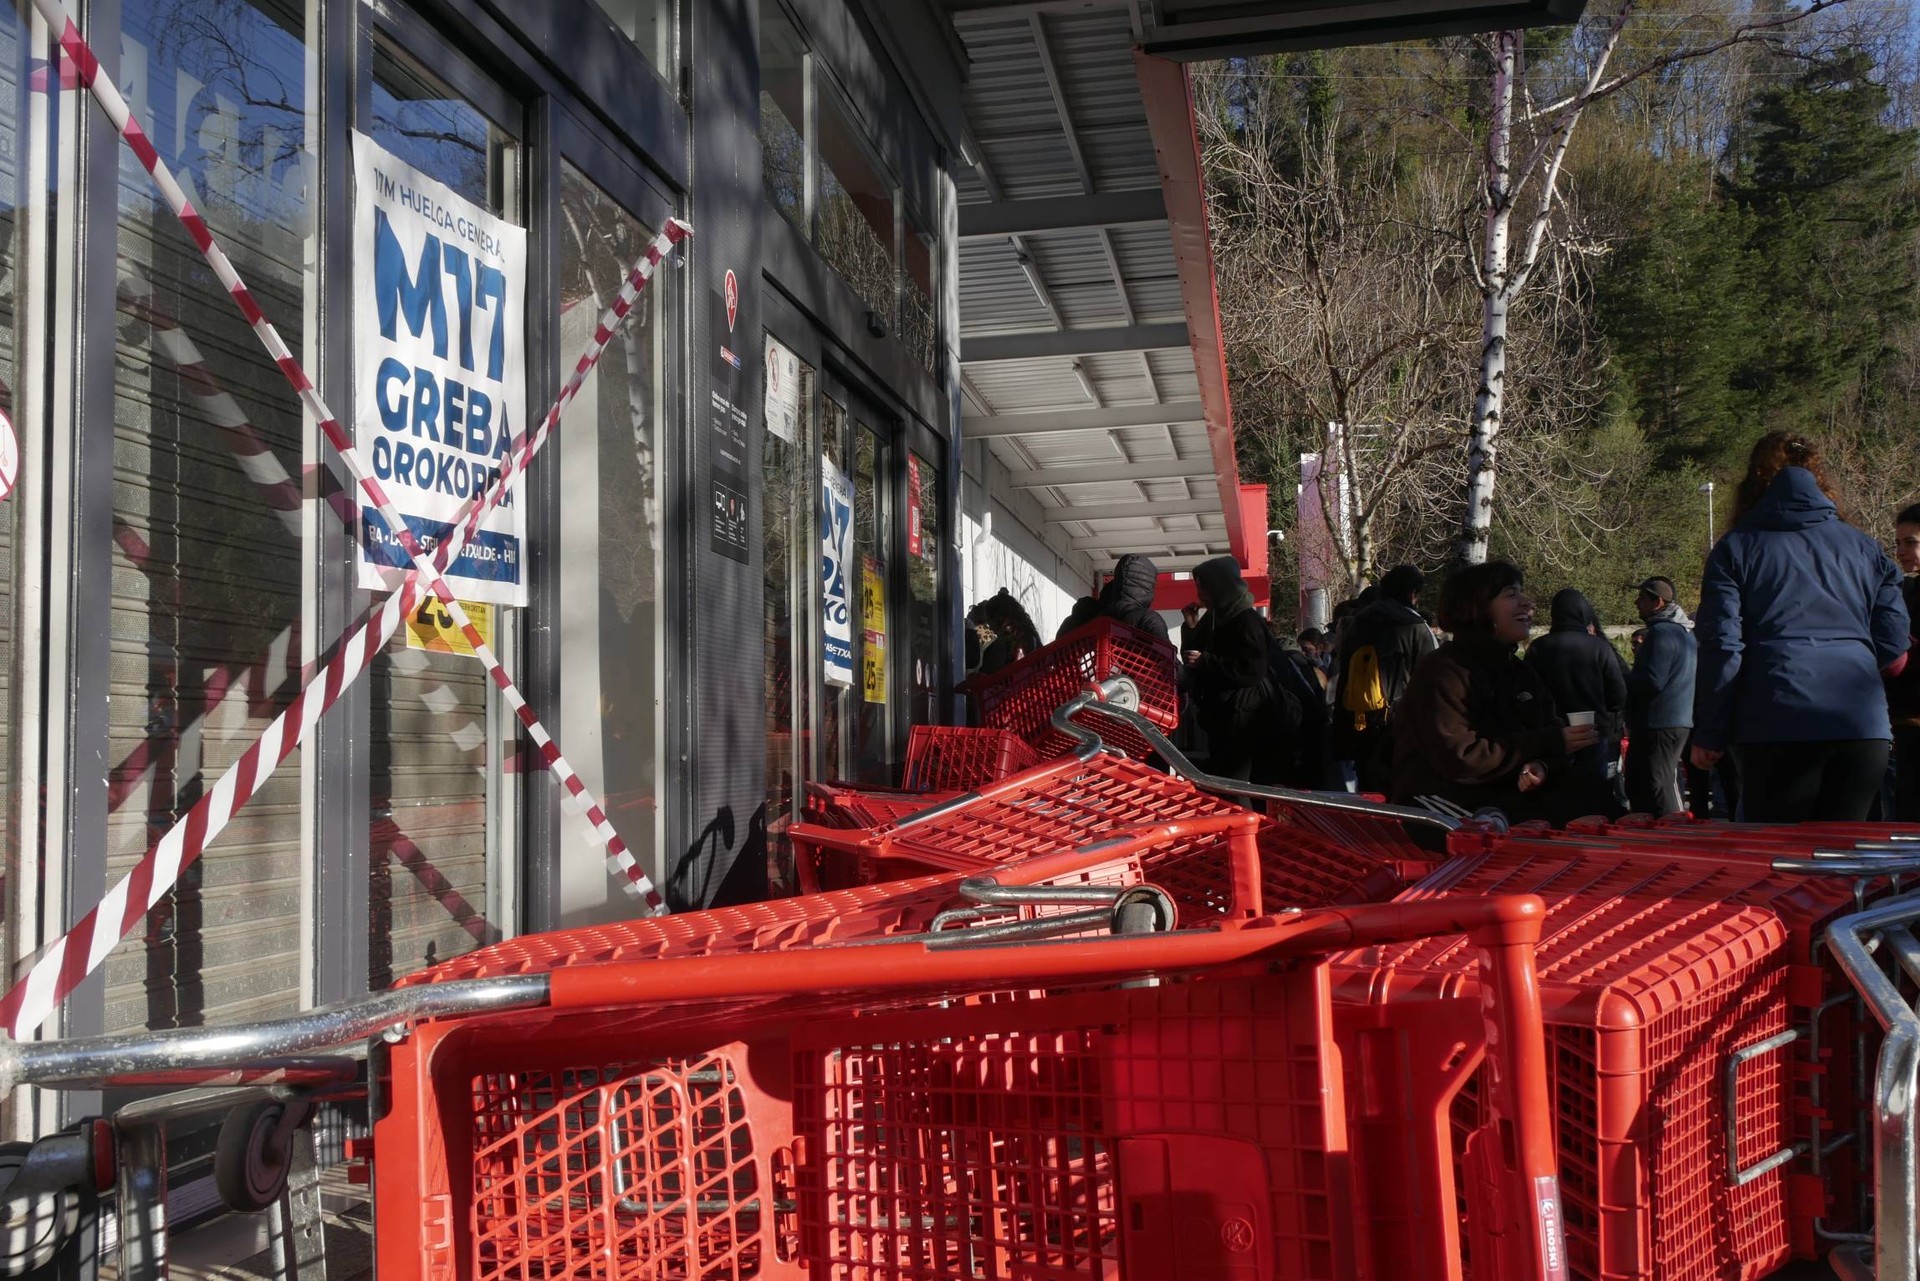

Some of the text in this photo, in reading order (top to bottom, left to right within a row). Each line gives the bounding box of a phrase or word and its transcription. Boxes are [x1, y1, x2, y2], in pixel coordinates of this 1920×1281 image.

[374, 167, 395, 202] 17M
[400, 185, 455, 233] HUELGA
[374, 204, 506, 383] M17
[376, 357, 512, 465] GREBA
[1545, 1219, 1558, 1268] EROSKI
